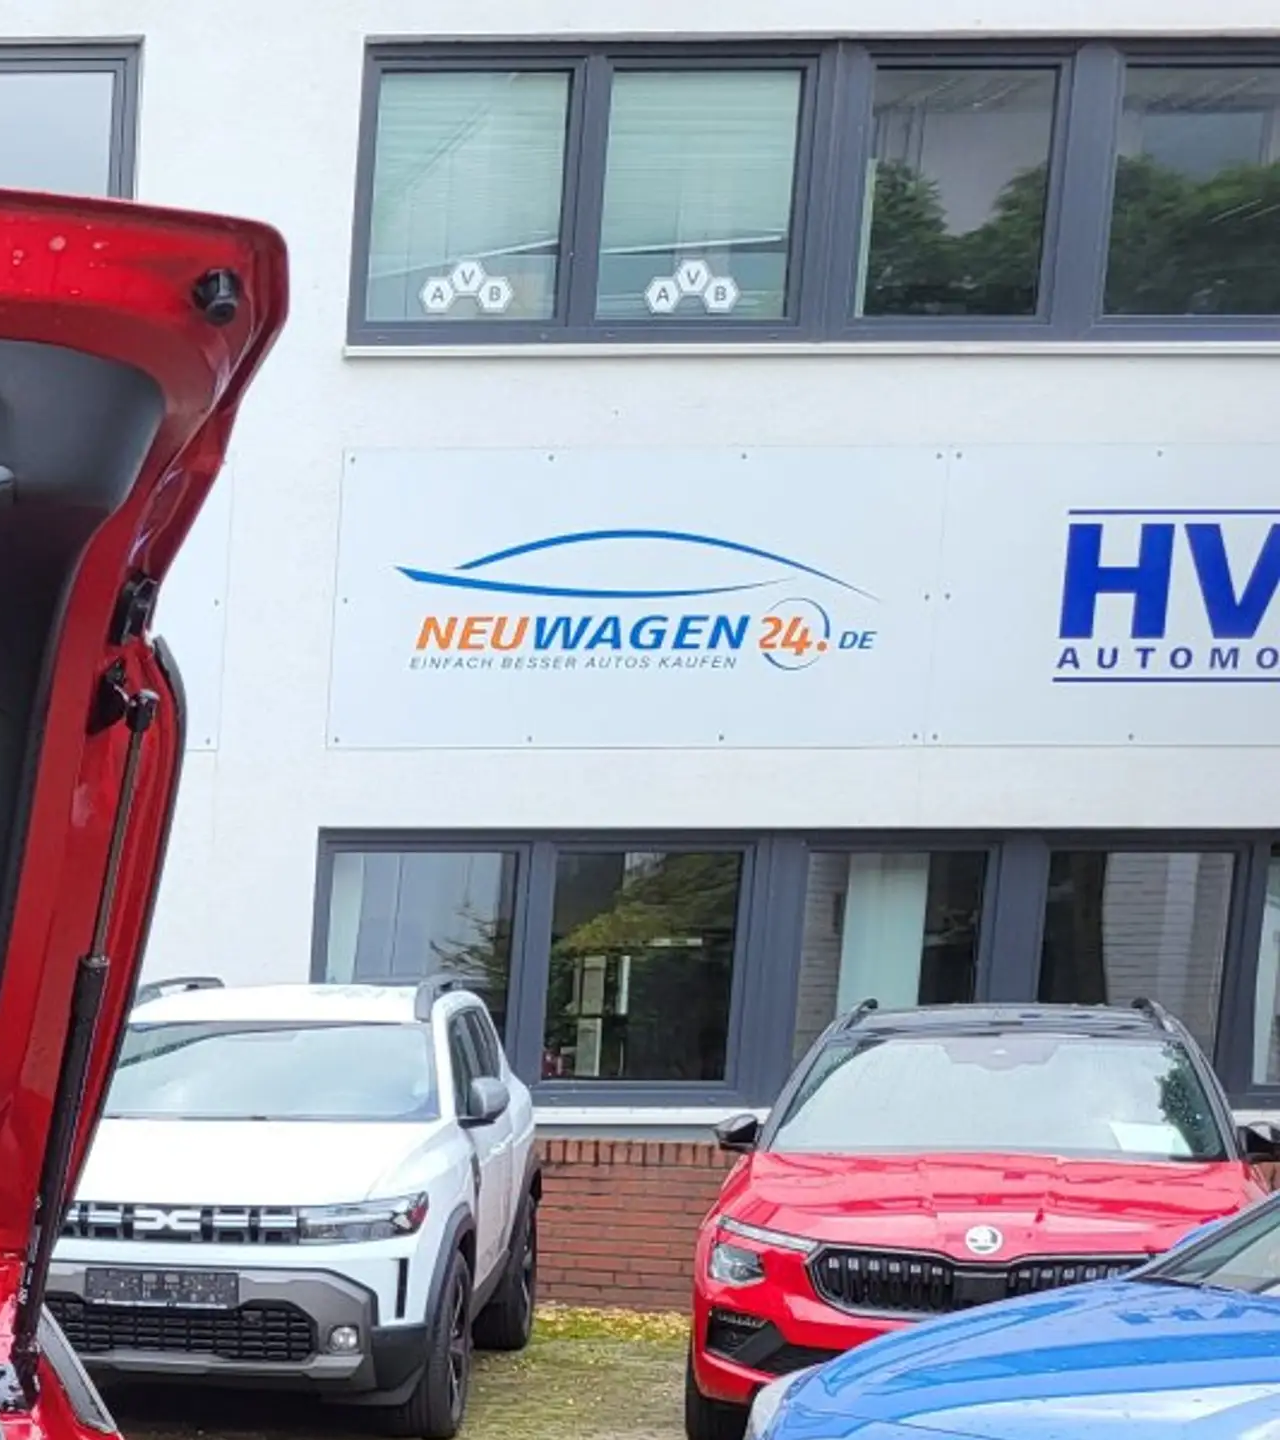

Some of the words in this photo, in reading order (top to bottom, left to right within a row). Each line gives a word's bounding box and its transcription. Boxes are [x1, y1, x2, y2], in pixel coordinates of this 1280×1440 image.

[409, 656, 492, 670] EINFACH
[500, 656, 578, 670] BESSER
[584, 655, 651, 669] AUTOS
[657, 655, 738, 669] KAUFEN
[1057, 646, 1280, 670] AUTOMO
